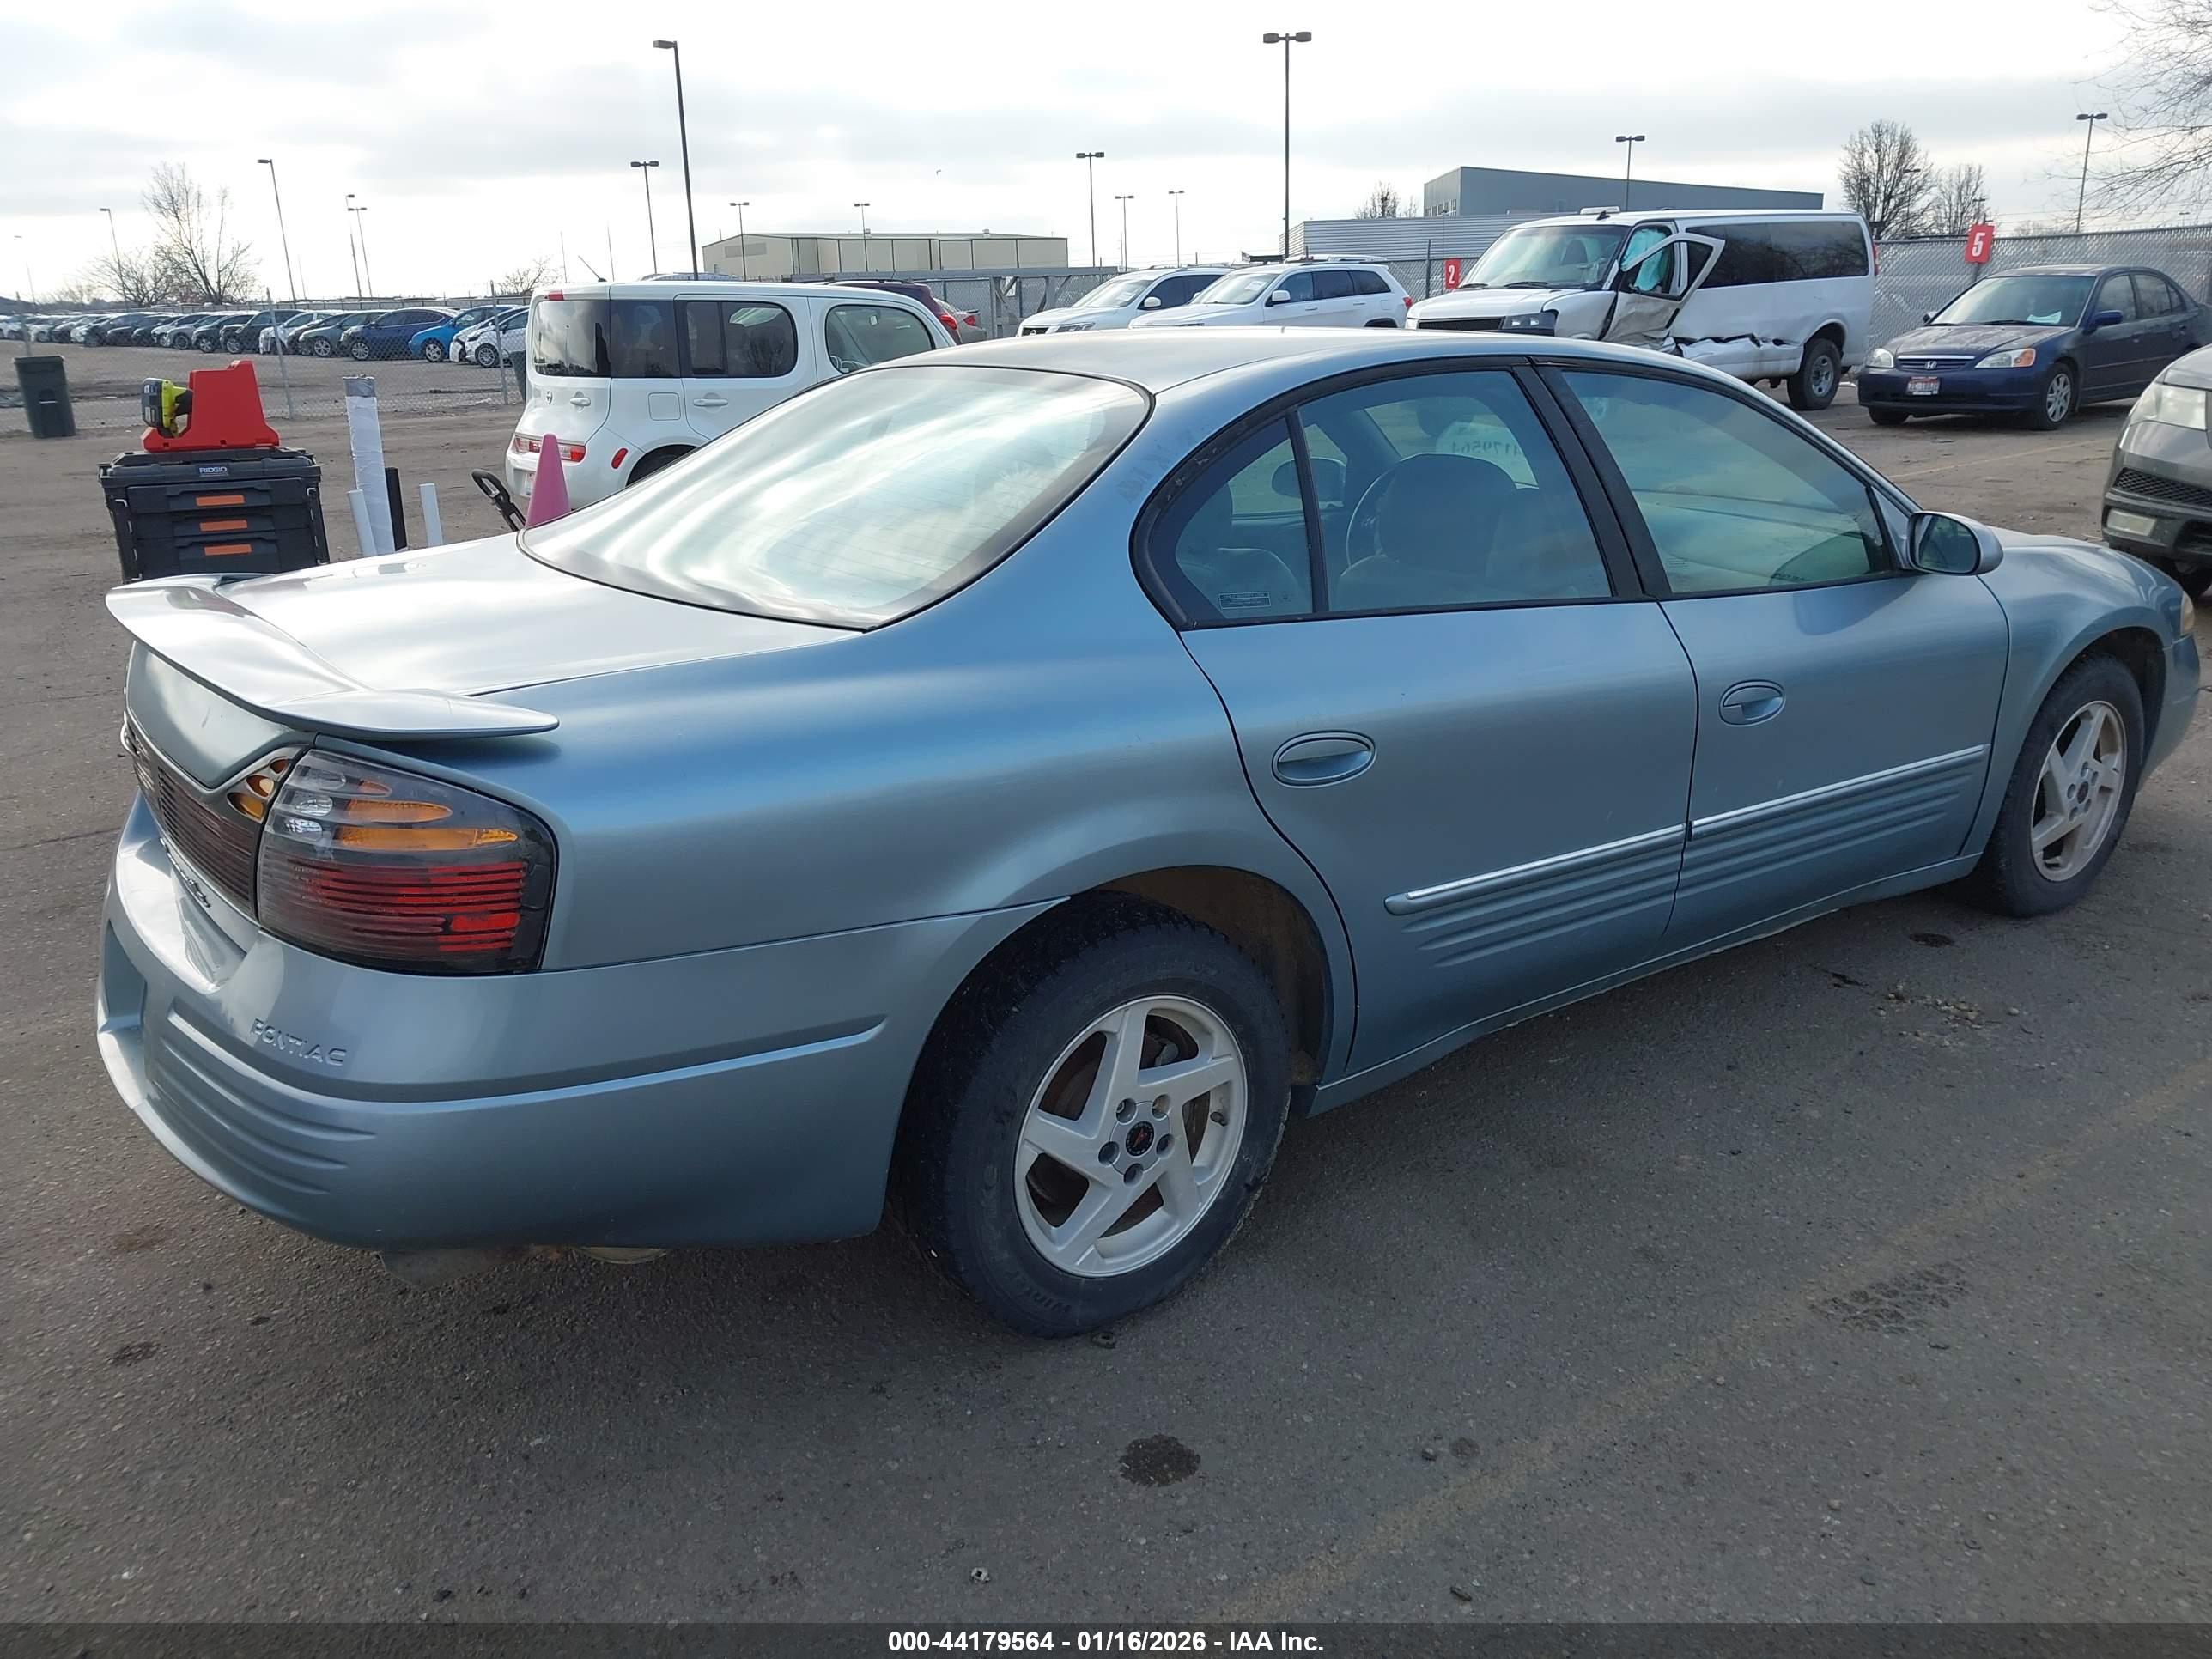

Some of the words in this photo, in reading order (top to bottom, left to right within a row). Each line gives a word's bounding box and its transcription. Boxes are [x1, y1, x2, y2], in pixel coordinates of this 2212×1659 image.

[1972, 232, 1986, 257] 5
[1449, 264, 1455, 284] 2
[250, 1018, 348, 1066] PONTIAC
